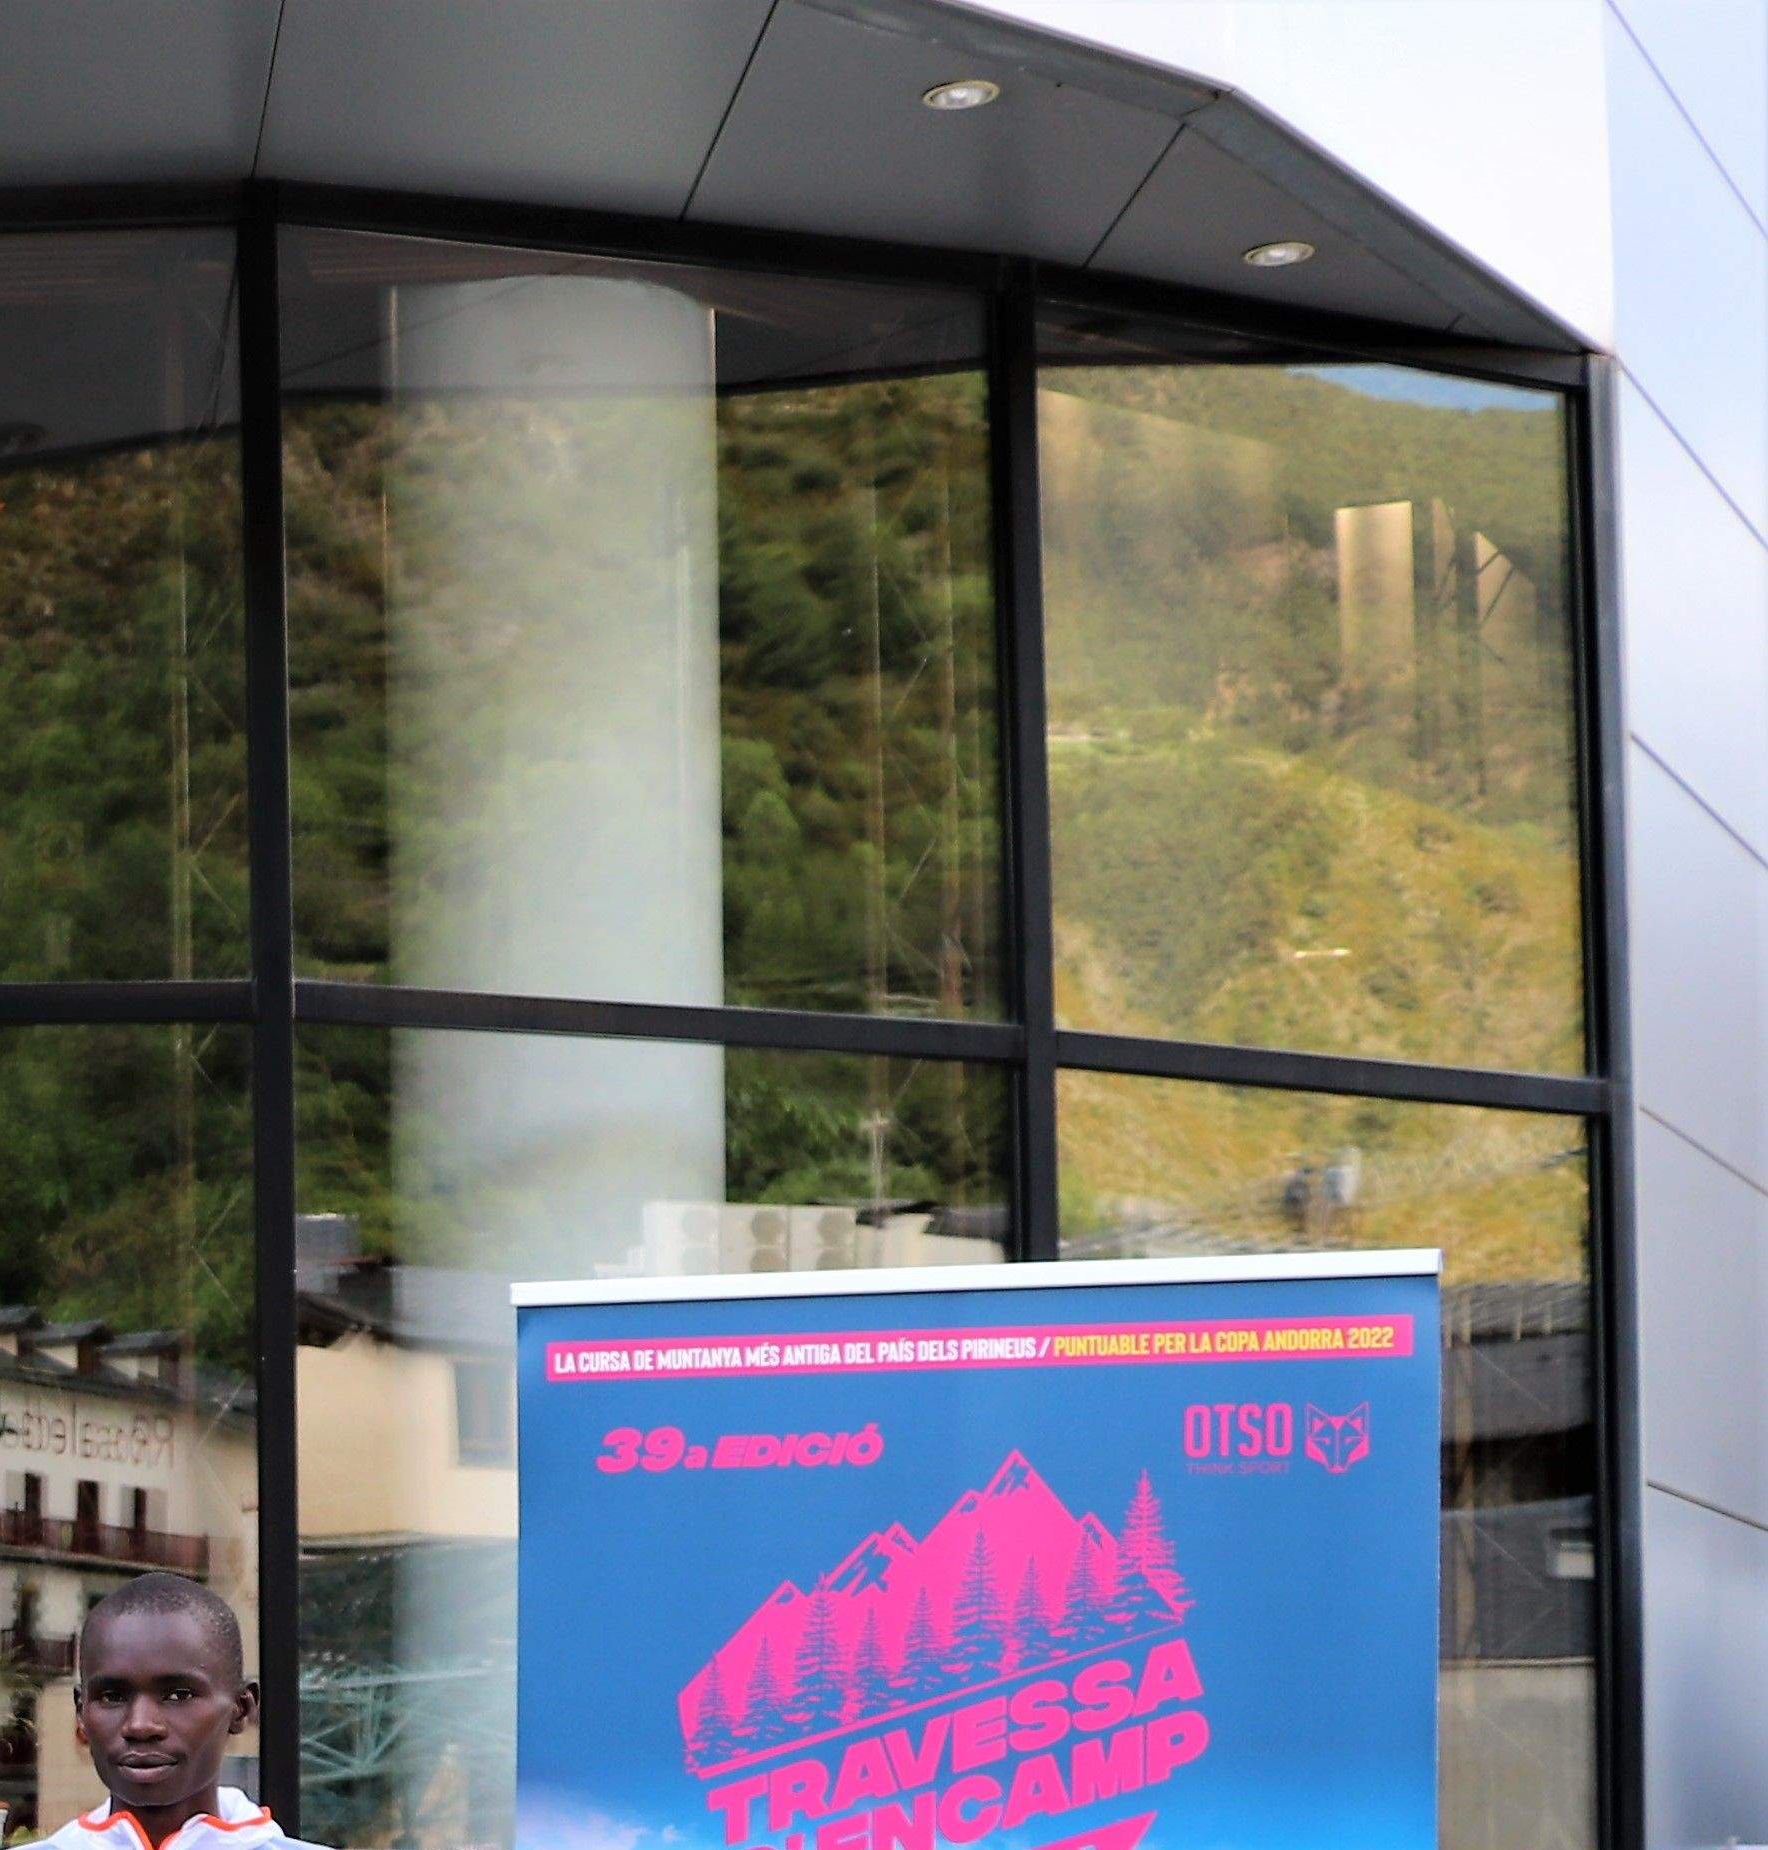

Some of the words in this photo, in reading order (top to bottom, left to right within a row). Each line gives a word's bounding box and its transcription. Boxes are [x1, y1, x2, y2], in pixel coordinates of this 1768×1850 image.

[555, 1351, 575, 1373] LA
[578, 1349, 631, 1372] CURSA
[633, 1348, 654, 1371] DE
[657, 1346, 742, 1370] MUNTANYA
[746, 1342, 781, 1368] MÉS
[783, 1343, 841, 1367] ANTIGA
[844, 1341, 875, 1365] DEL
[877, 1337, 915, 1364] PAÍS
[917, 1339, 959, 1362] DELS
[962, 1336, 1037, 1361] PIRINEUS
[1054, 1332, 1149, 1358] PUNTUABLE
[1153, 1331, 1187, 1354] PER
[1190, 1331, 1213, 1353] LA
[1215, 1329, 1259, 1352] COPA
[1263, 1327, 1344, 1351] ANDORRA
[1347, 1326, 1394, 1349] 2022
[711, 1422, 884, 1469] EDICIÓ
[1183, 1402, 1293, 1459] OTSO
[1186, 1463, 1236, 1475] THINK
[1239, 1462, 1290, 1475] SPORT
[706, 1638, 1205, 1846] TRAVESSA
